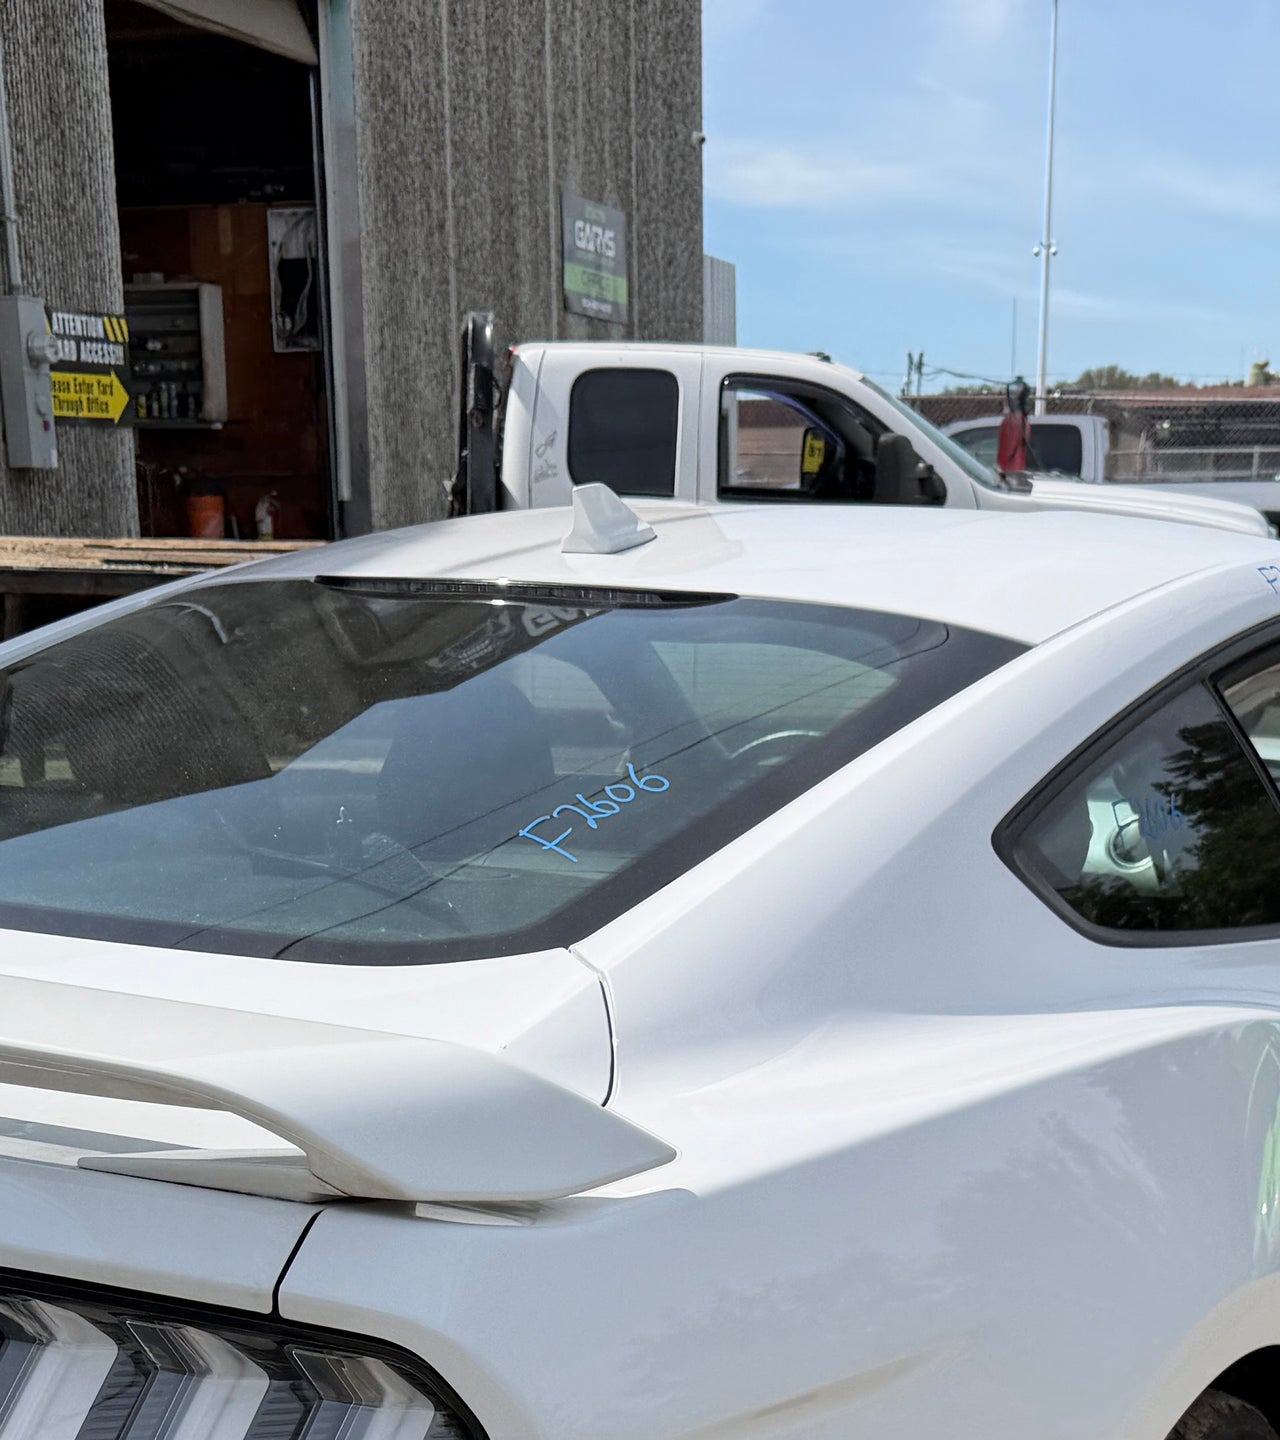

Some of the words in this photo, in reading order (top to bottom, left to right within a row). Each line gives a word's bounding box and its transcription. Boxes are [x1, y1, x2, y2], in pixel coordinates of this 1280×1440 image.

[51, 311, 105, 339] ATTENTION
[56, 339, 78, 362] ARD
[52, 379, 71, 394] ease
[518, 761, 671, 864] F2606
